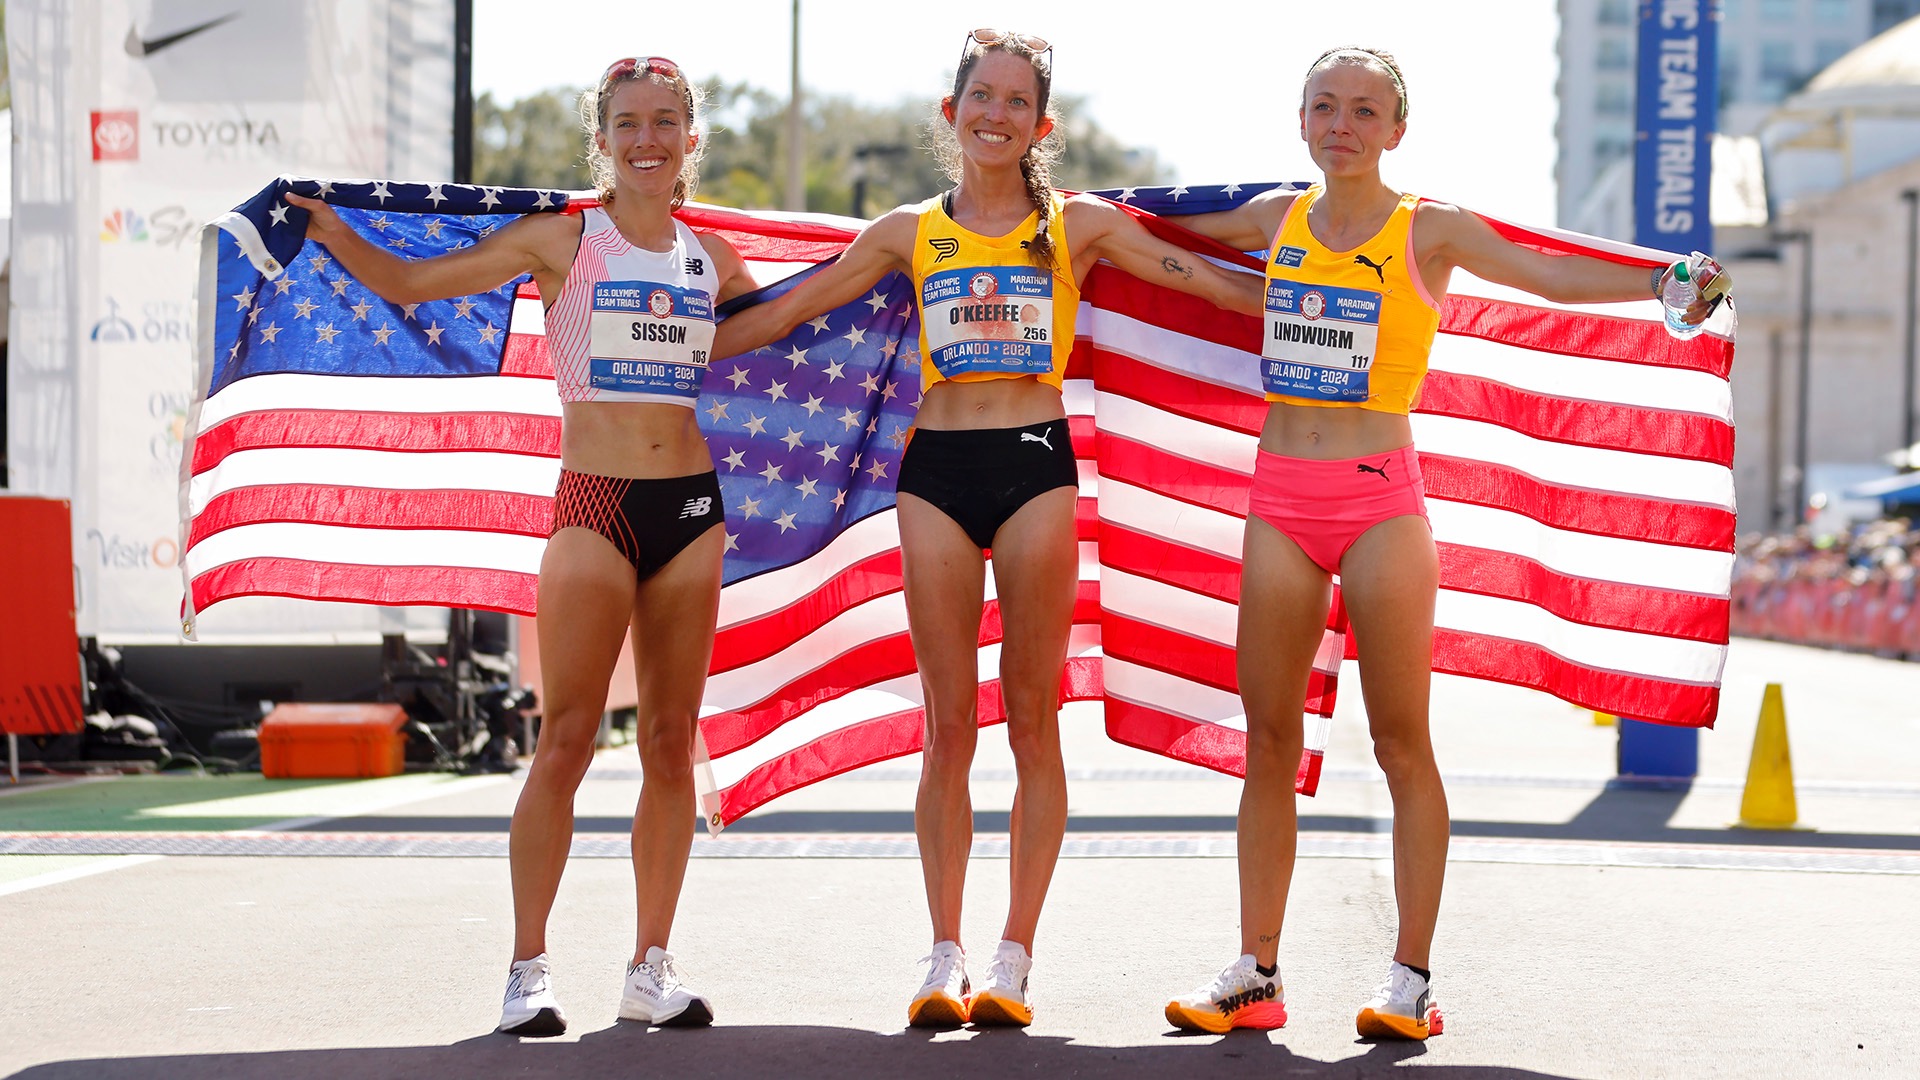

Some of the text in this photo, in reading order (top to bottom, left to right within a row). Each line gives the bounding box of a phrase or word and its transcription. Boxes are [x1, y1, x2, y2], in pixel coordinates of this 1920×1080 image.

[1658, 35, 1699, 119] TEAM
[152, 120, 281, 147] TOYOTA
[1655, 125, 1697, 234] TRIALS
[934, 277, 960, 290] OLYMPIC
[1010, 275, 1048, 286] MARATHON
[597, 288, 611, 297] U.S.
[611, 288, 640, 298] OLYMPIC
[924, 290, 939, 302] TEAM
[938, 286, 961, 298] TRIALS
[1273, 287, 1294, 299] OLYMPIC
[596, 297, 641, 308] TEAM TRIALS
[1275, 298, 1293, 309] TRIALS
[1337, 297, 1376, 311] MARATHON
[949, 304, 1019, 325] O'KEEFFE
[631, 321, 687, 345] SISSON
[1023, 326, 1047, 341] 256
[1273, 321, 1354, 350] LINDWURM
[691, 350, 707, 364] 103
[943, 342, 990, 362] ORLANDO
[1002, 343, 1031, 357] 2024
[1351, 354, 1369, 369] 111
[612, 362, 695, 381] ORLANDO 2024
[1268, 362, 1311, 380] ORLANDO
[1320, 369, 1350, 386] 2024
[1214, 981, 1277, 1019] NITRO
